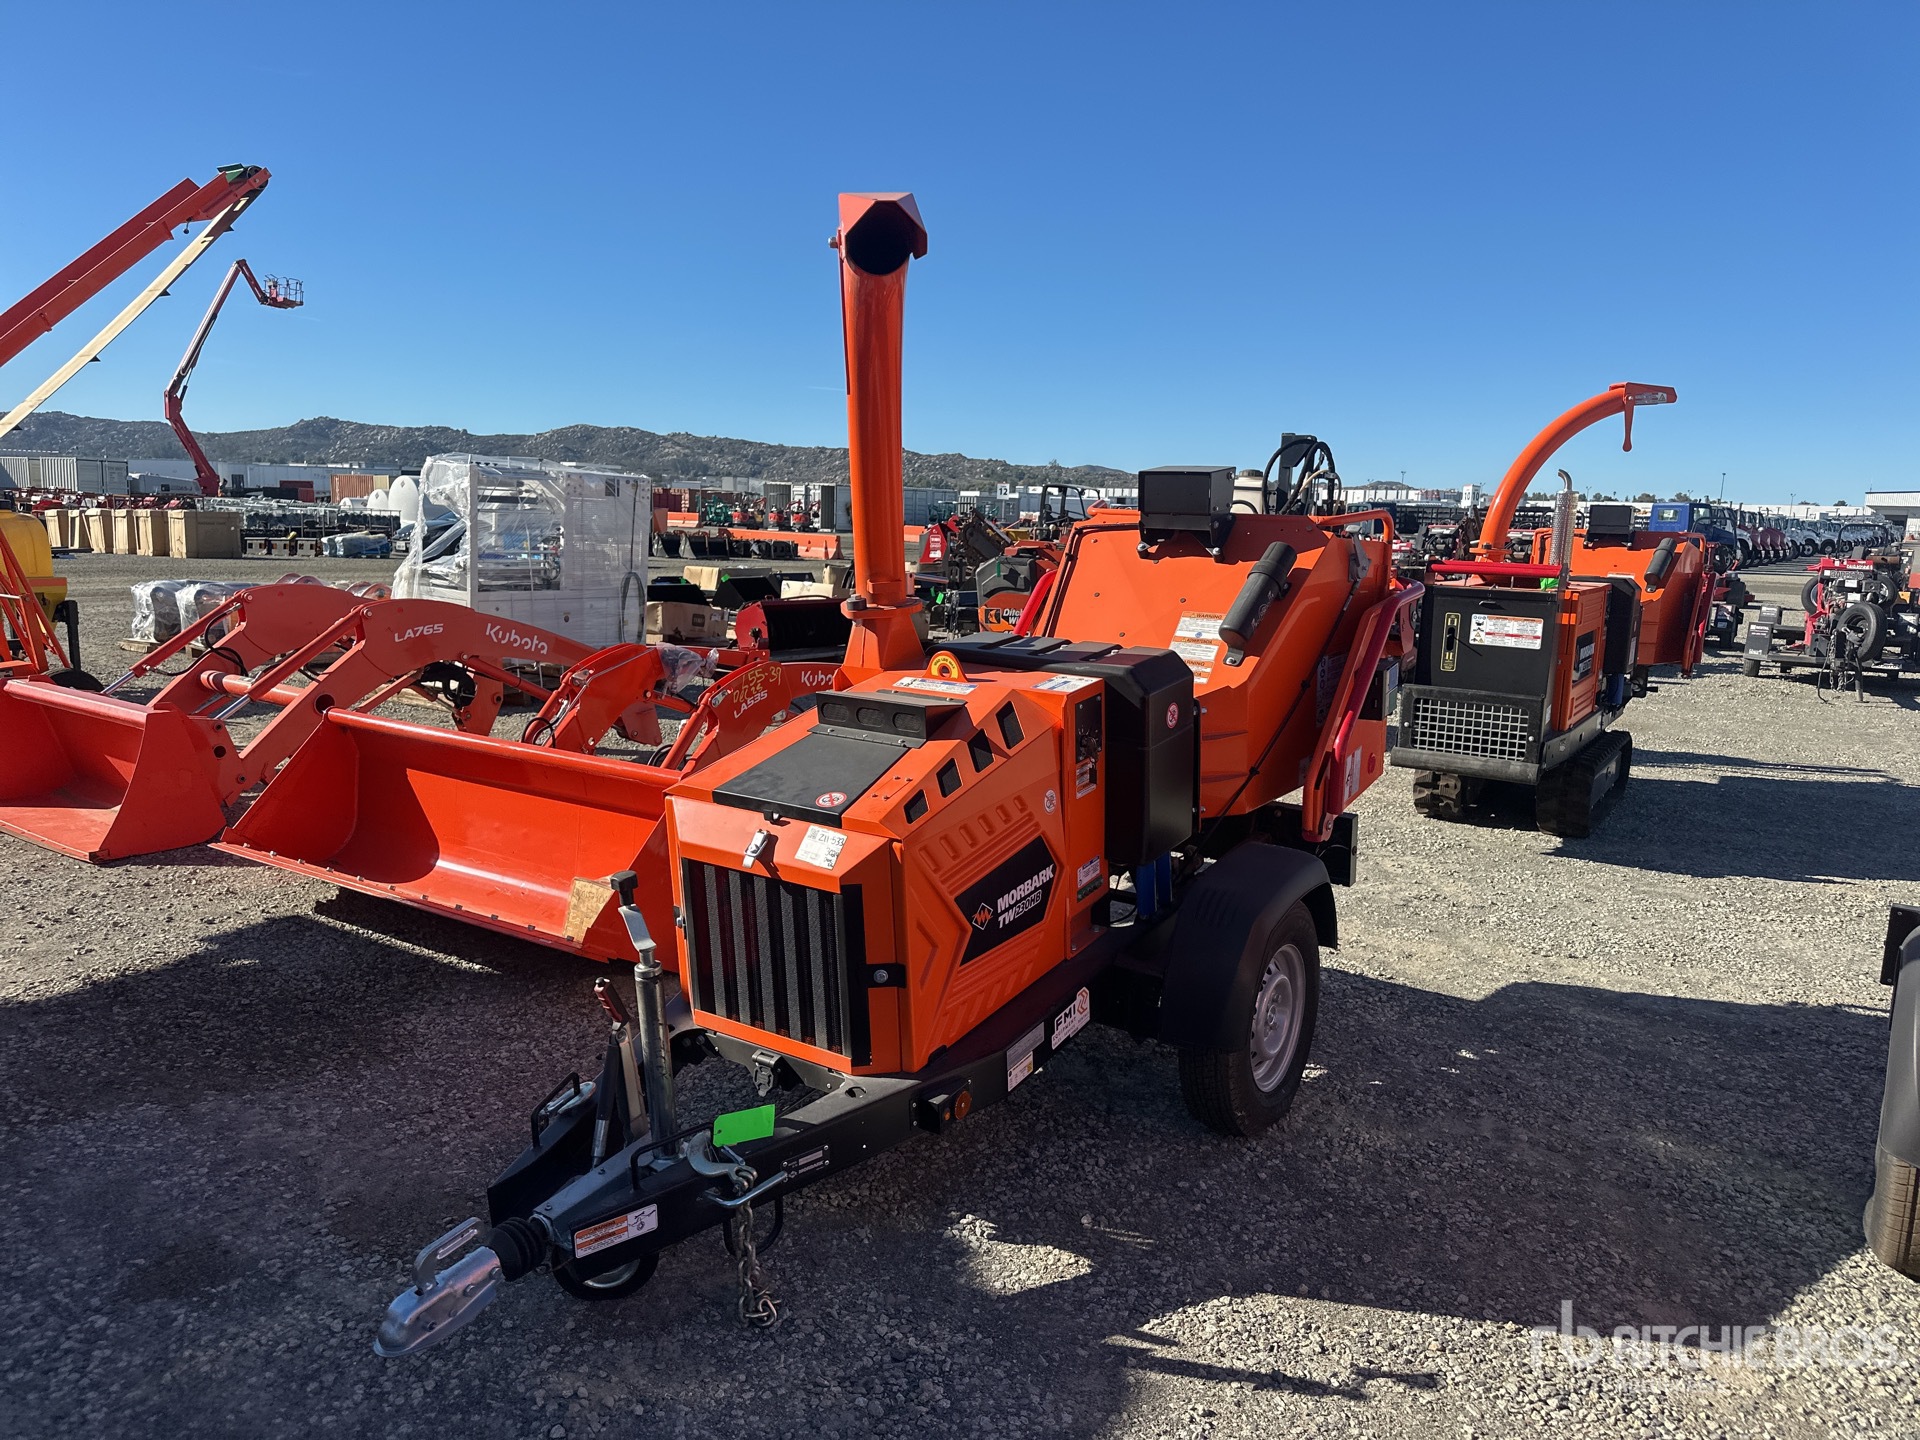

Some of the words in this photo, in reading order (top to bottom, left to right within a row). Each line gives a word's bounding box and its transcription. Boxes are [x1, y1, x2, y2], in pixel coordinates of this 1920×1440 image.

[998, 487, 1008, 496] 12
[394, 623, 444, 643] LA765
[485, 622, 548, 655] Kubota
[801, 670, 833, 687] Kubo
[733, 690, 768, 719] LA535
[997, 863, 1054, 914] MORBARK
[998, 889, 1042, 929] TW230HB
[1055, 1003, 1076, 1031] FMI
